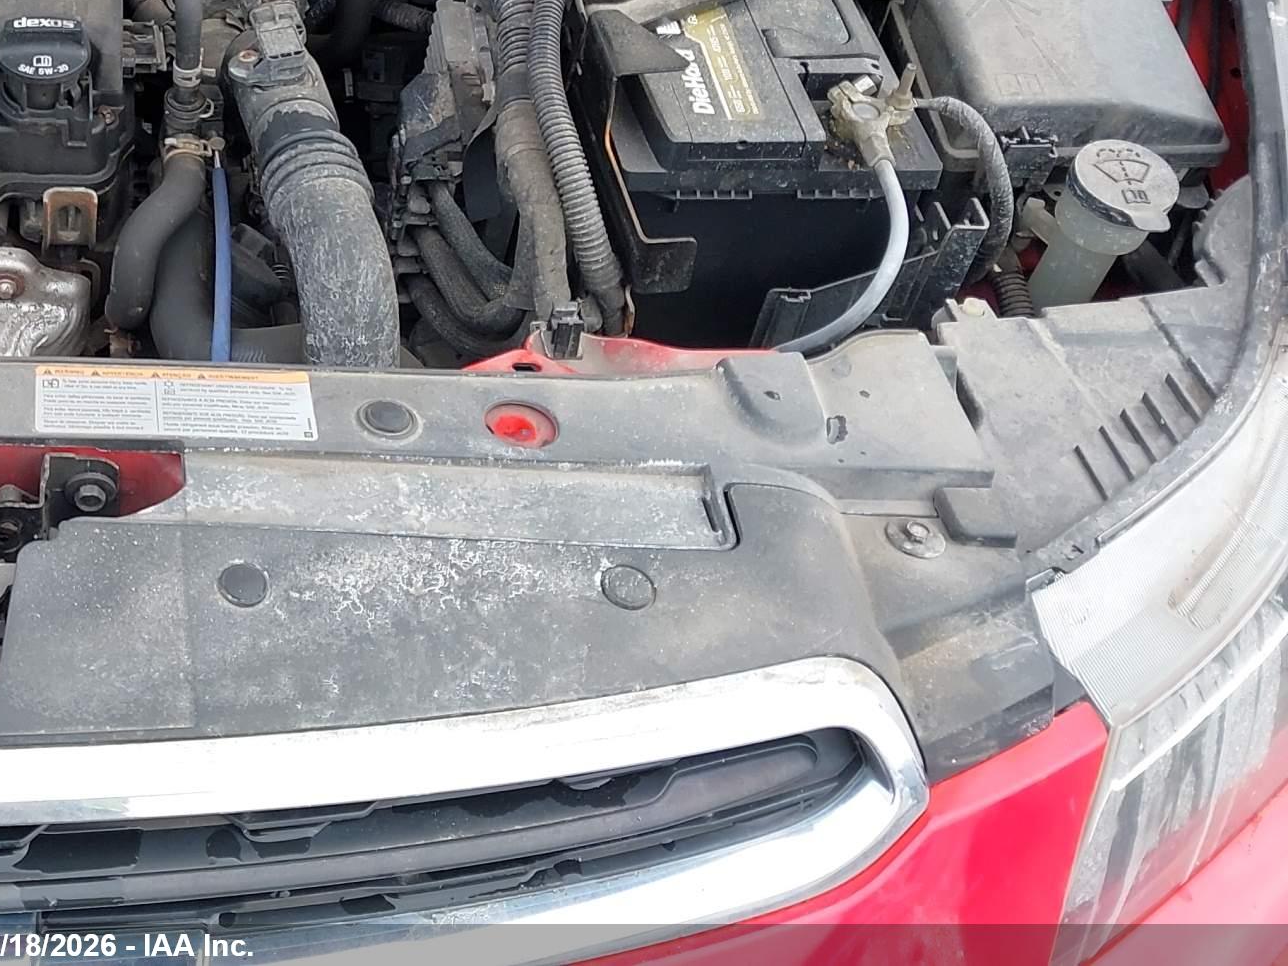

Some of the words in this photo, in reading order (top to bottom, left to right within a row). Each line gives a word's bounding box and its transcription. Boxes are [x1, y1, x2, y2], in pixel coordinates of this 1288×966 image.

[13, 16, 75, 29] dexos
[17, 63, 36, 75] SAE
[674, 48, 715, 115] DieHad
